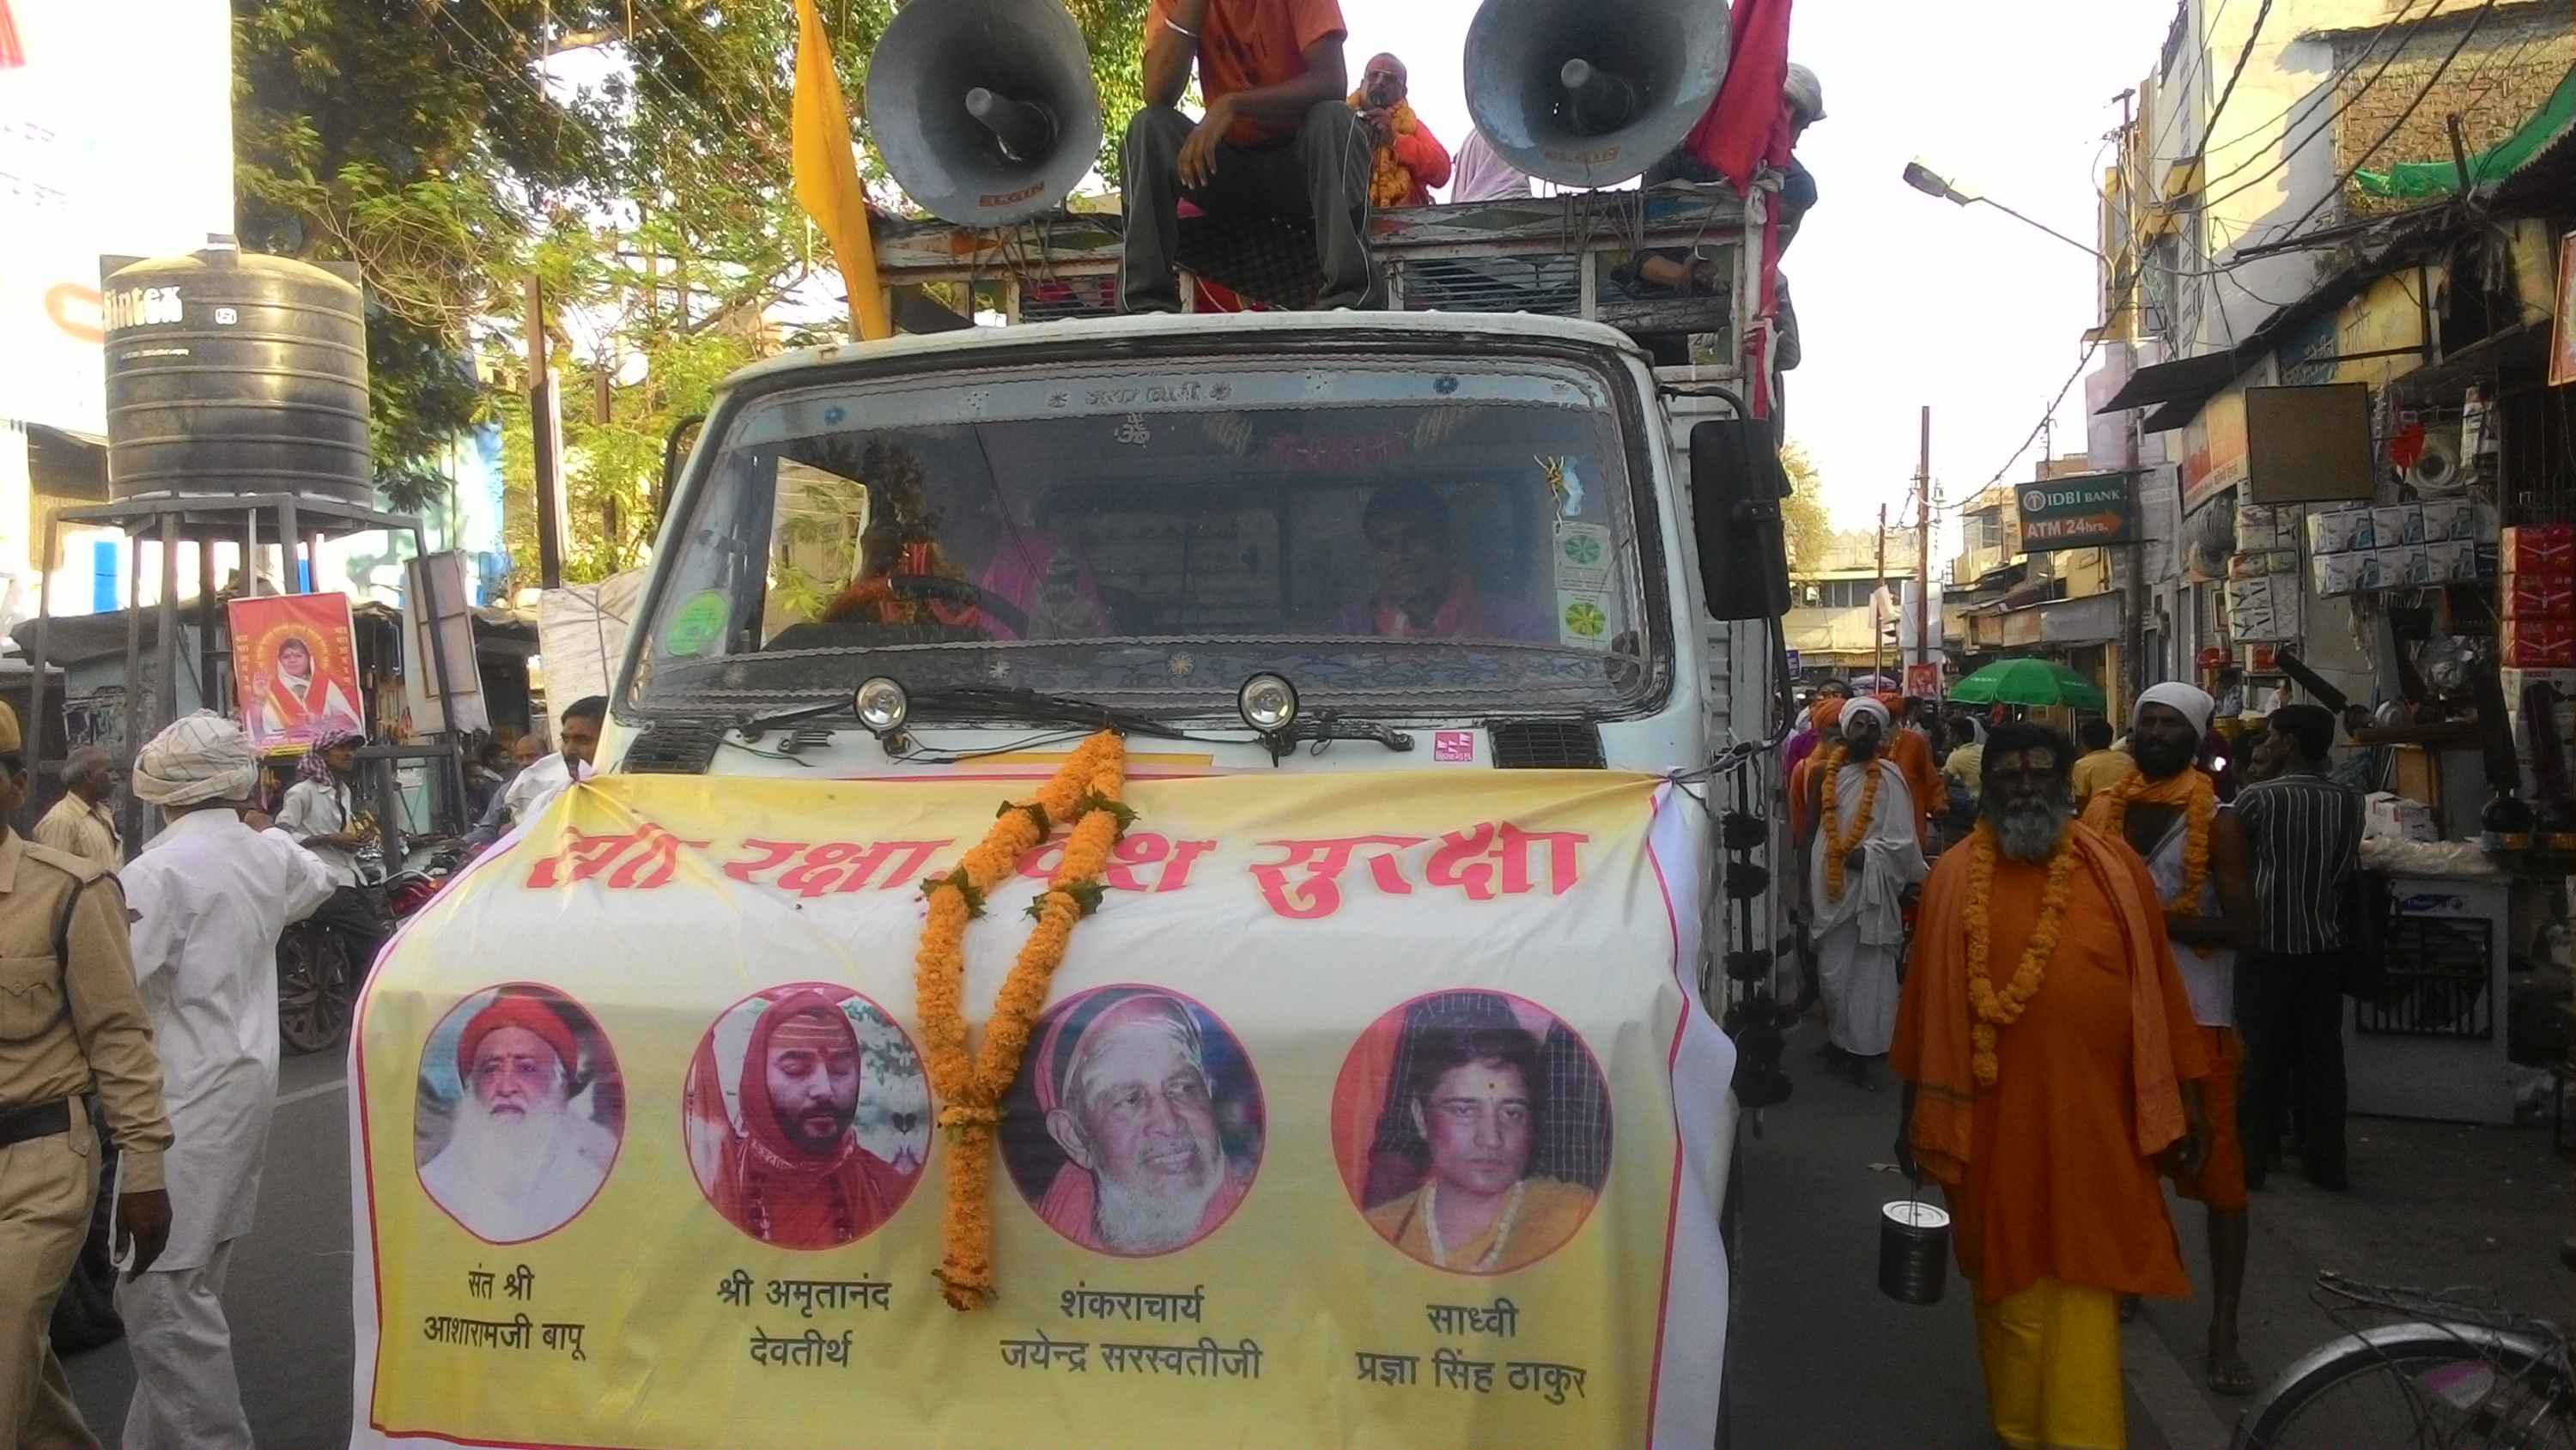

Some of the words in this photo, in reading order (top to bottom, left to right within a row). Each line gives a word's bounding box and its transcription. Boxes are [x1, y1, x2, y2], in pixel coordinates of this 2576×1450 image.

[2047, 490, 2081, 507] IDBI
[2085, 489, 2121, 503] BANK
[2026, 520, 2061, 538] ATM
[468, 1263, 496, 1301] संत
[503, 1263, 536, 1301] श्री
[716, 1268, 755, 1307] श्री
[765, 1272, 892, 1319] अमृतानंद
[1060, 1281, 1205, 1324] शंकराचार्य
[423, 1313, 534, 1350] आशारामजी
[541, 1323, 587, 1362] बापू
[1425, 1297, 1520, 1338] साध्वी
[750, 1325, 854, 1368] देवतीर्थ
[999, 1328, 1090, 1374] जयेन्द्र
[1100, 1337, 1264, 1380] सरस्वतीजी
[1355, 1351, 1420, 1386] प्रज्ञा
[1431, 1347, 1496, 1394] सिंह
[1506, 1362, 1588, 1405] ठाकुर
